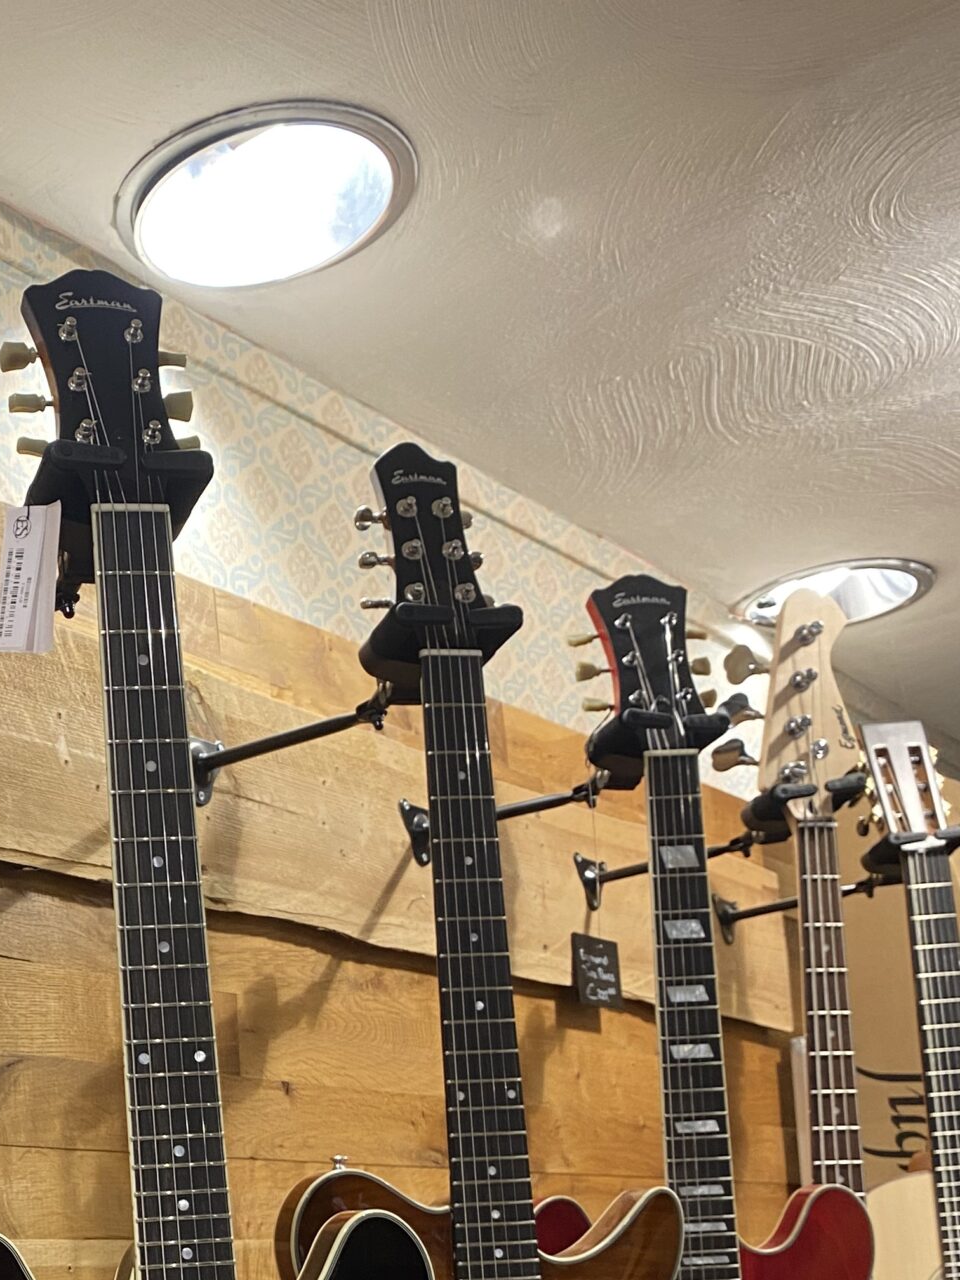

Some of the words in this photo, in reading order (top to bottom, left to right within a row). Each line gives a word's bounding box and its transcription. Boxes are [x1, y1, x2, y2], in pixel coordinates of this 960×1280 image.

[55, 291, 137, 313] Eastman
[391, 469, 447, 485] Eastman
[612, 592, 671, 608] Eastman
